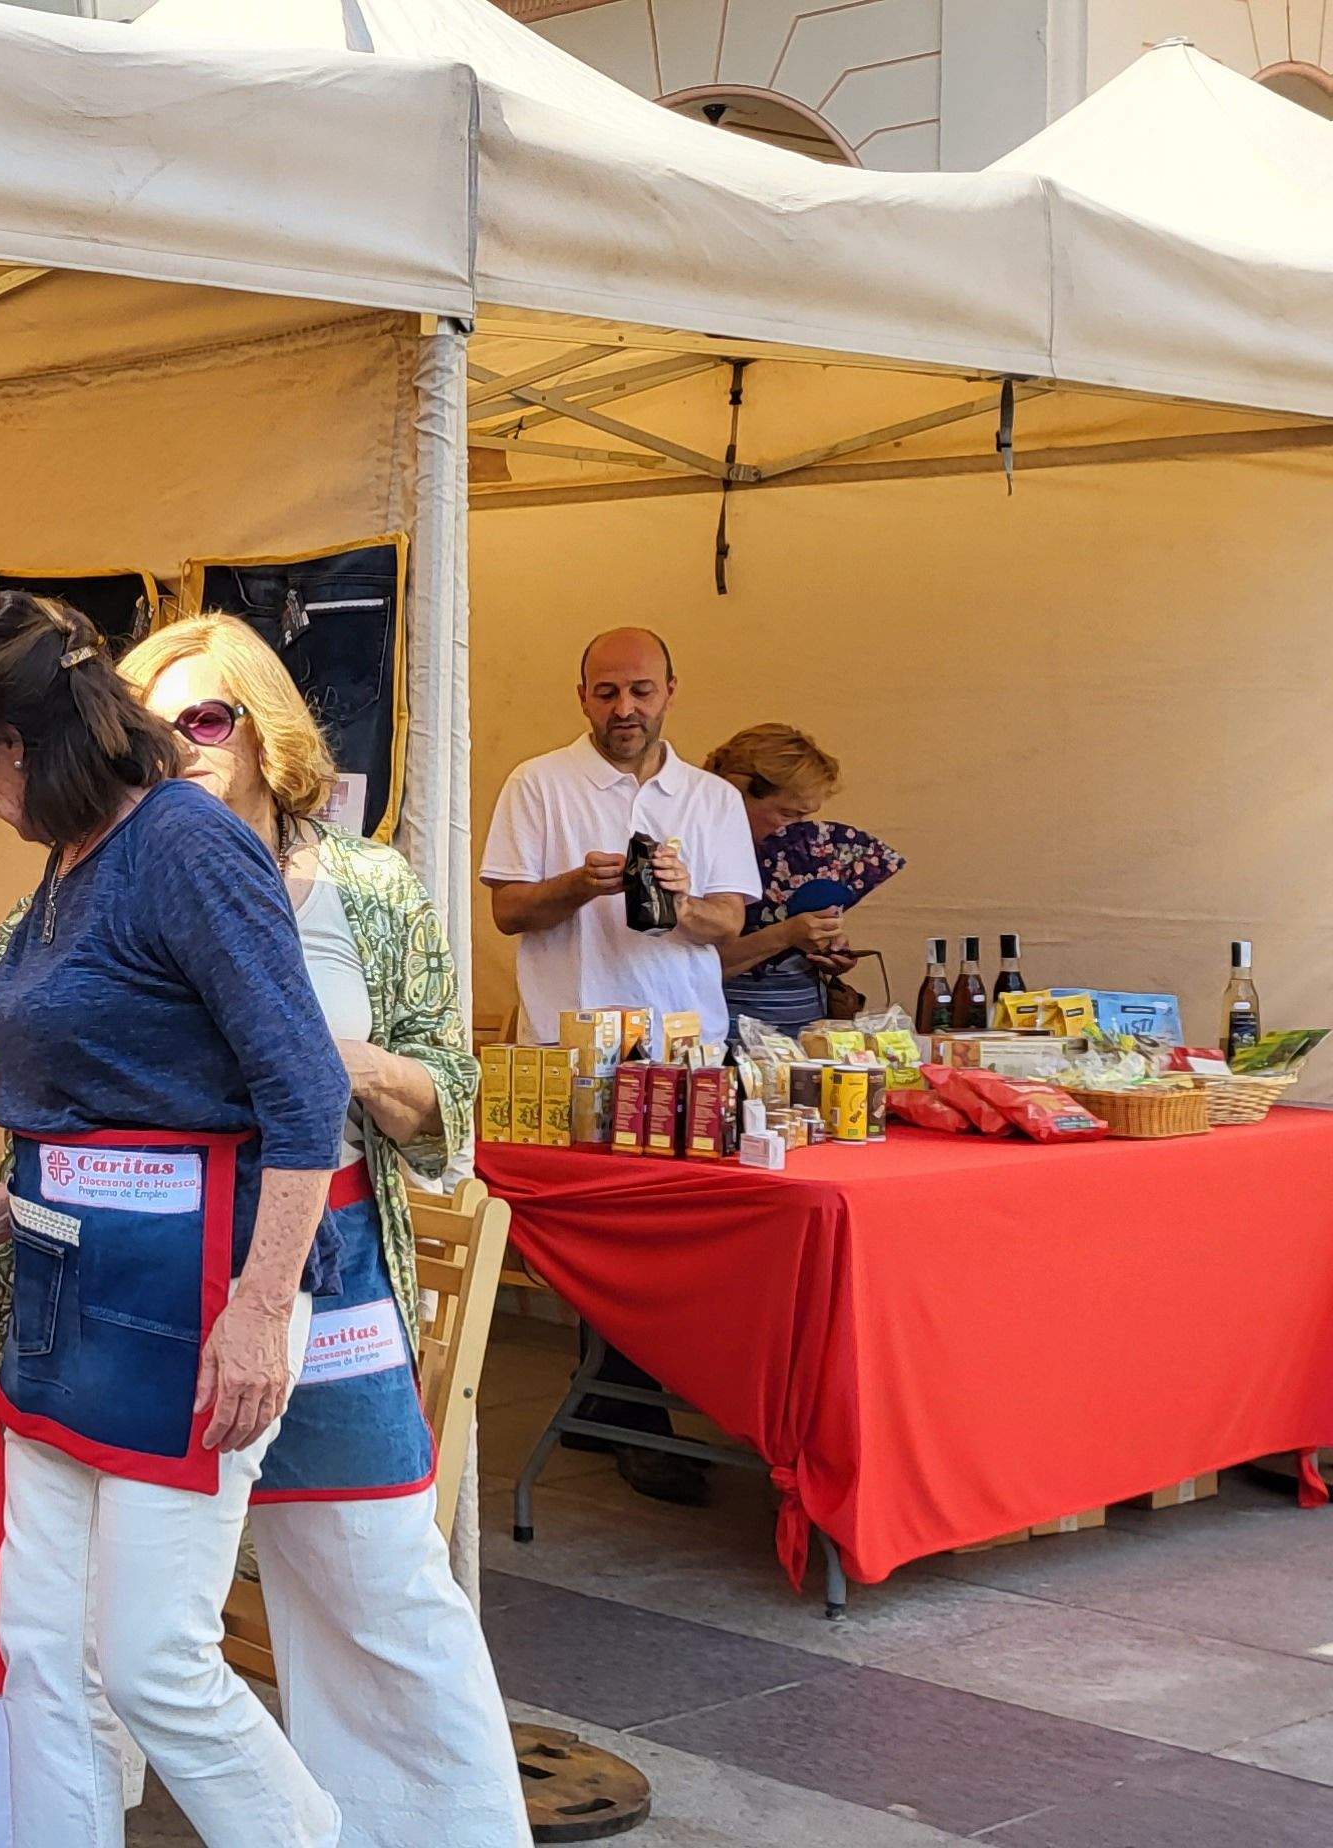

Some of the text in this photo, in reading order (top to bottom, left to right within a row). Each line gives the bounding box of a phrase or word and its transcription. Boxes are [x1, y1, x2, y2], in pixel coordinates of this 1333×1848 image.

[77, 1154, 175, 1176] Cáritas
[79, 1176, 196, 1189] Diocesana de Huesca
[78, 1185, 168, 1201] Programa de Empleo
[314, 1325, 378, 1348] áritas
